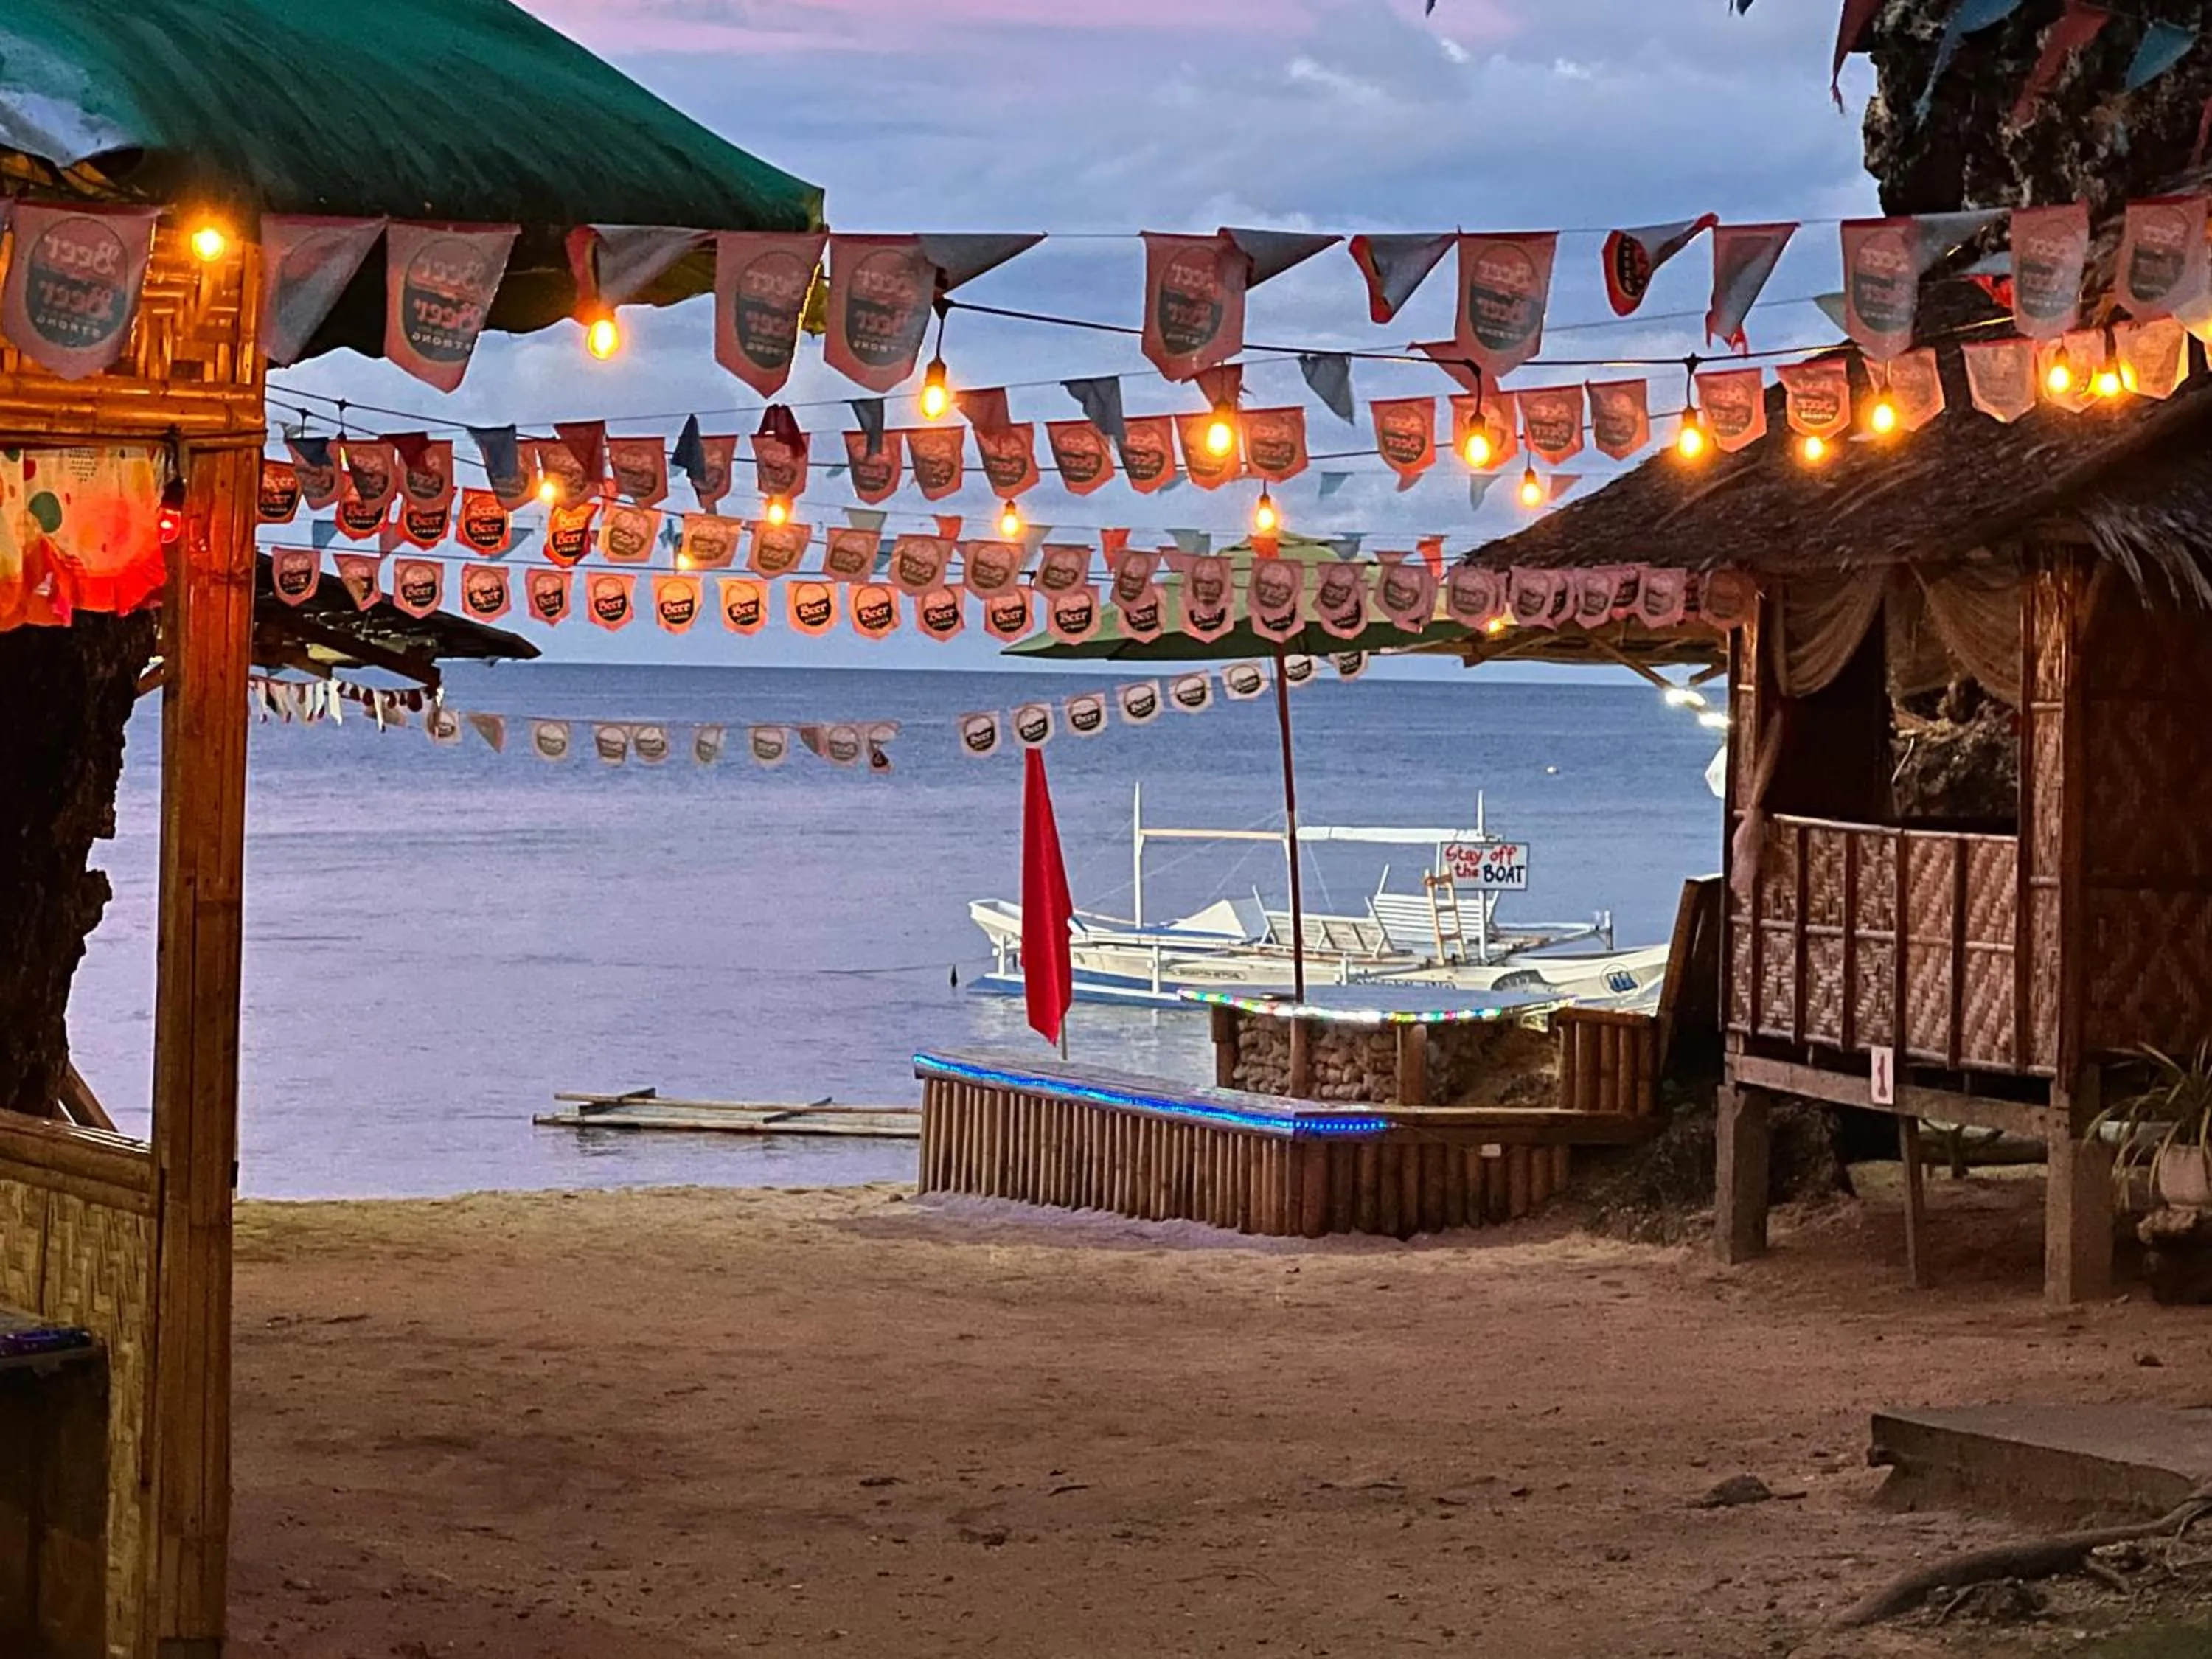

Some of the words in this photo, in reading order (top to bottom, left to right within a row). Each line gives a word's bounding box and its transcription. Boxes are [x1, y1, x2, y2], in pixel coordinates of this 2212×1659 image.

[598, 598, 624, 611] Beer
[663, 600, 692, 615] Beer
[800, 602, 827, 616] Beer
[1059, 610, 1088, 622] Beer
[1445, 844, 1483, 865] Stay
[1489, 845, 1516, 864] off
[1455, 863, 1479, 878] the
[1483, 865, 1525, 883] BOAT
